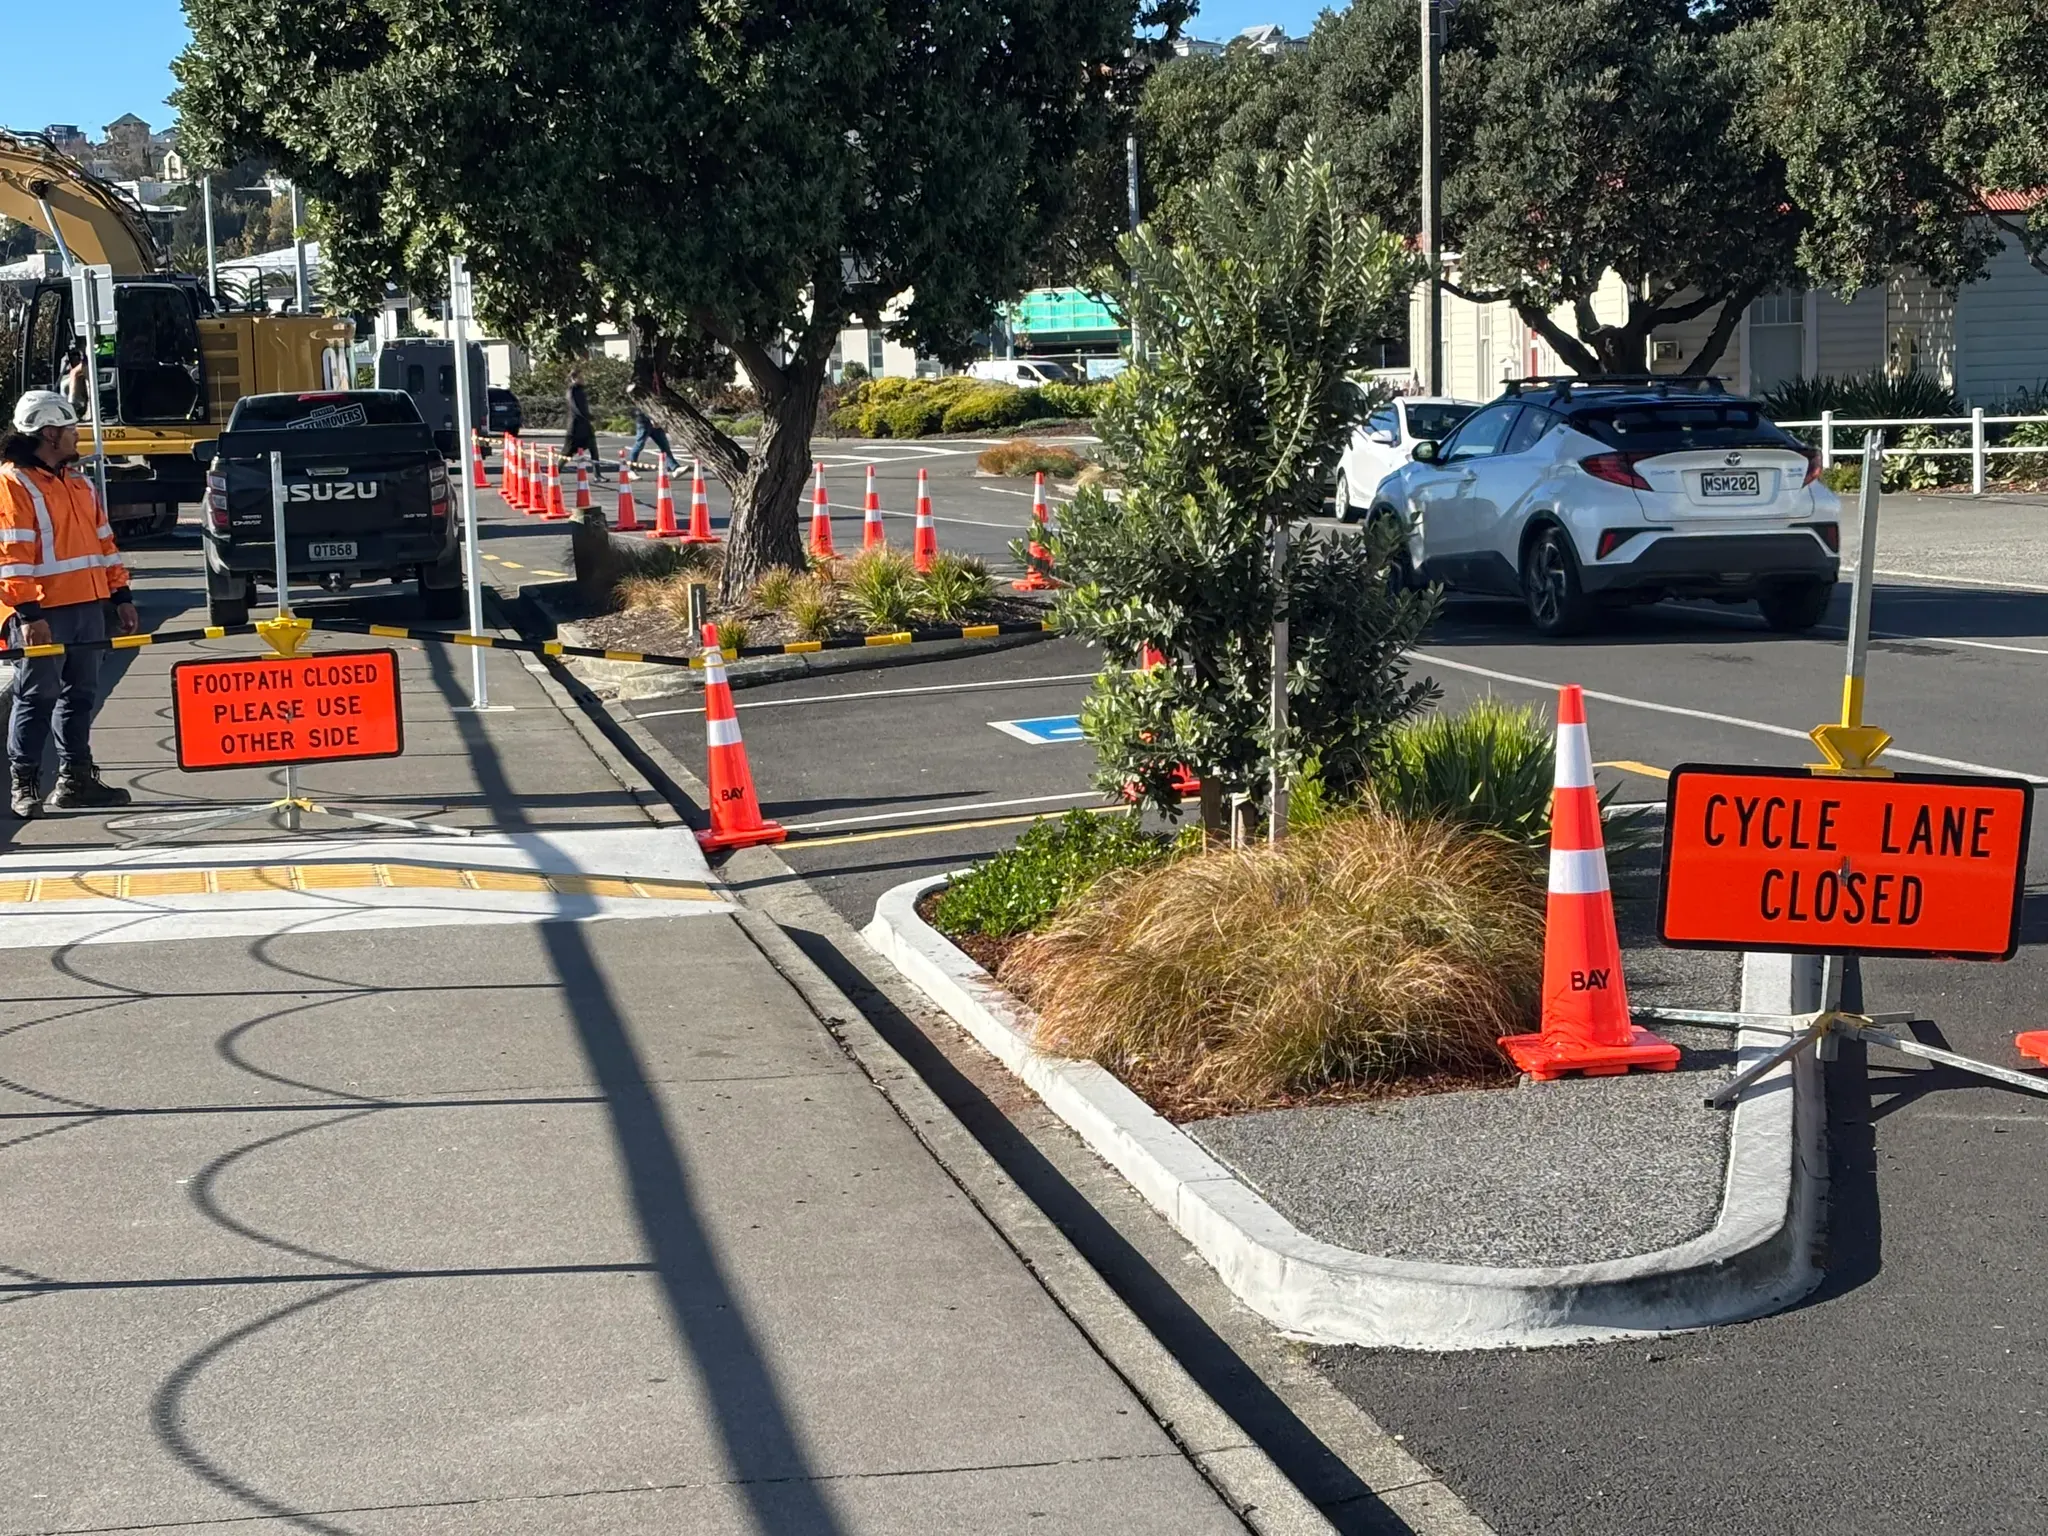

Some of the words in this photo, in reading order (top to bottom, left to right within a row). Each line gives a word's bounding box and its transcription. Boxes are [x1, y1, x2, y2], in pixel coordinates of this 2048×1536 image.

[281, 481, 378, 502] ISUZU
[1705, 476, 1756, 491] MSM202
[313, 544, 352, 557] QTB68
[193, 669, 293, 694] FOOTPATH
[304, 664, 377, 687] CLOSED
[213, 699, 305, 724] PLEASE
[317, 695, 362, 716] USE
[220, 731, 294, 754] OTHER
[308, 726, 359, 748] SIDE
[721, 786, 745, 802] BAY
[1704, 793, 1842, 850] CYCLE
[1881, 802, 1995, 858] LANE
[1760, 869, 1924, 926] CLOSED
[1571, 968, 1611, 991] BAY
